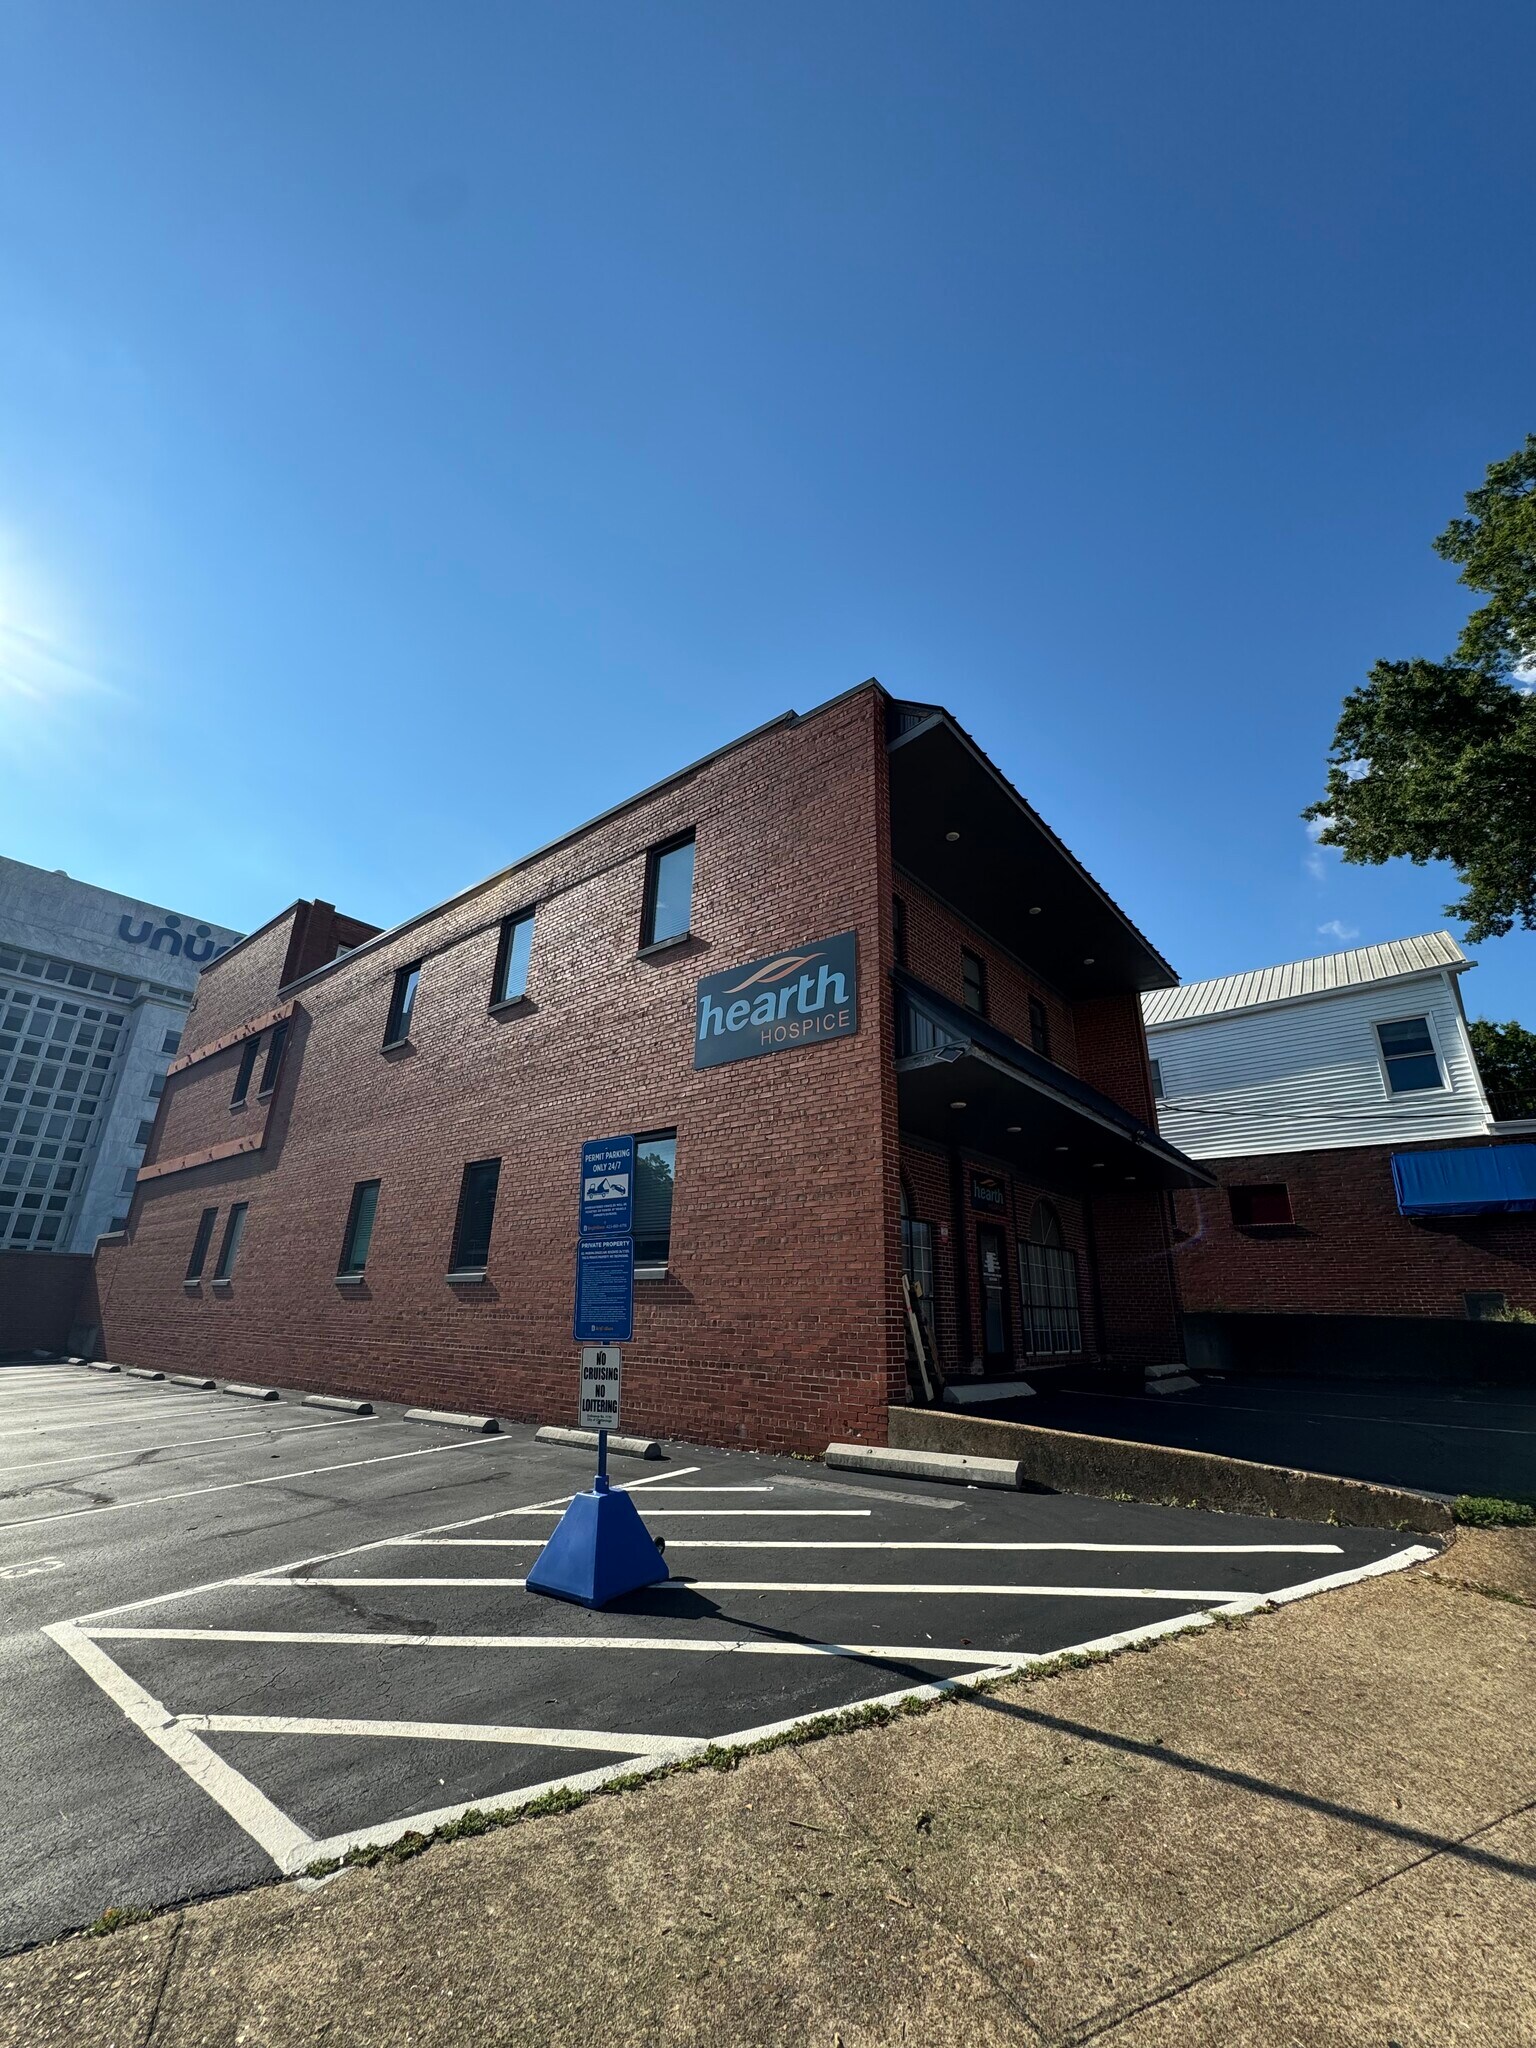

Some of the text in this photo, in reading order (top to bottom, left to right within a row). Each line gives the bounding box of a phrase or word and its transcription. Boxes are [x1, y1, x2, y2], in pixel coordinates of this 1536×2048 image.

[119, 914, 243, 962] unu
[698, 964, 850, 1041] hearth
[760, 1009, 850, 1046] HOSPICE
[585, 1149, 630, 1162] PERMIT PARKING
[592, 1161, 621, 1173] ONLY 24/7
[973, 1179, 1004, 1205] hearth
[581, 1240, 630, 1249] PRIVATE PROPERTY
[596, 1351, 607, 1366] NO
[583, 1366, 618, 1381] CRUISING
[595, 1384, 606, 1398] NO
[582, 1398, 618, 1414] LOITERING
